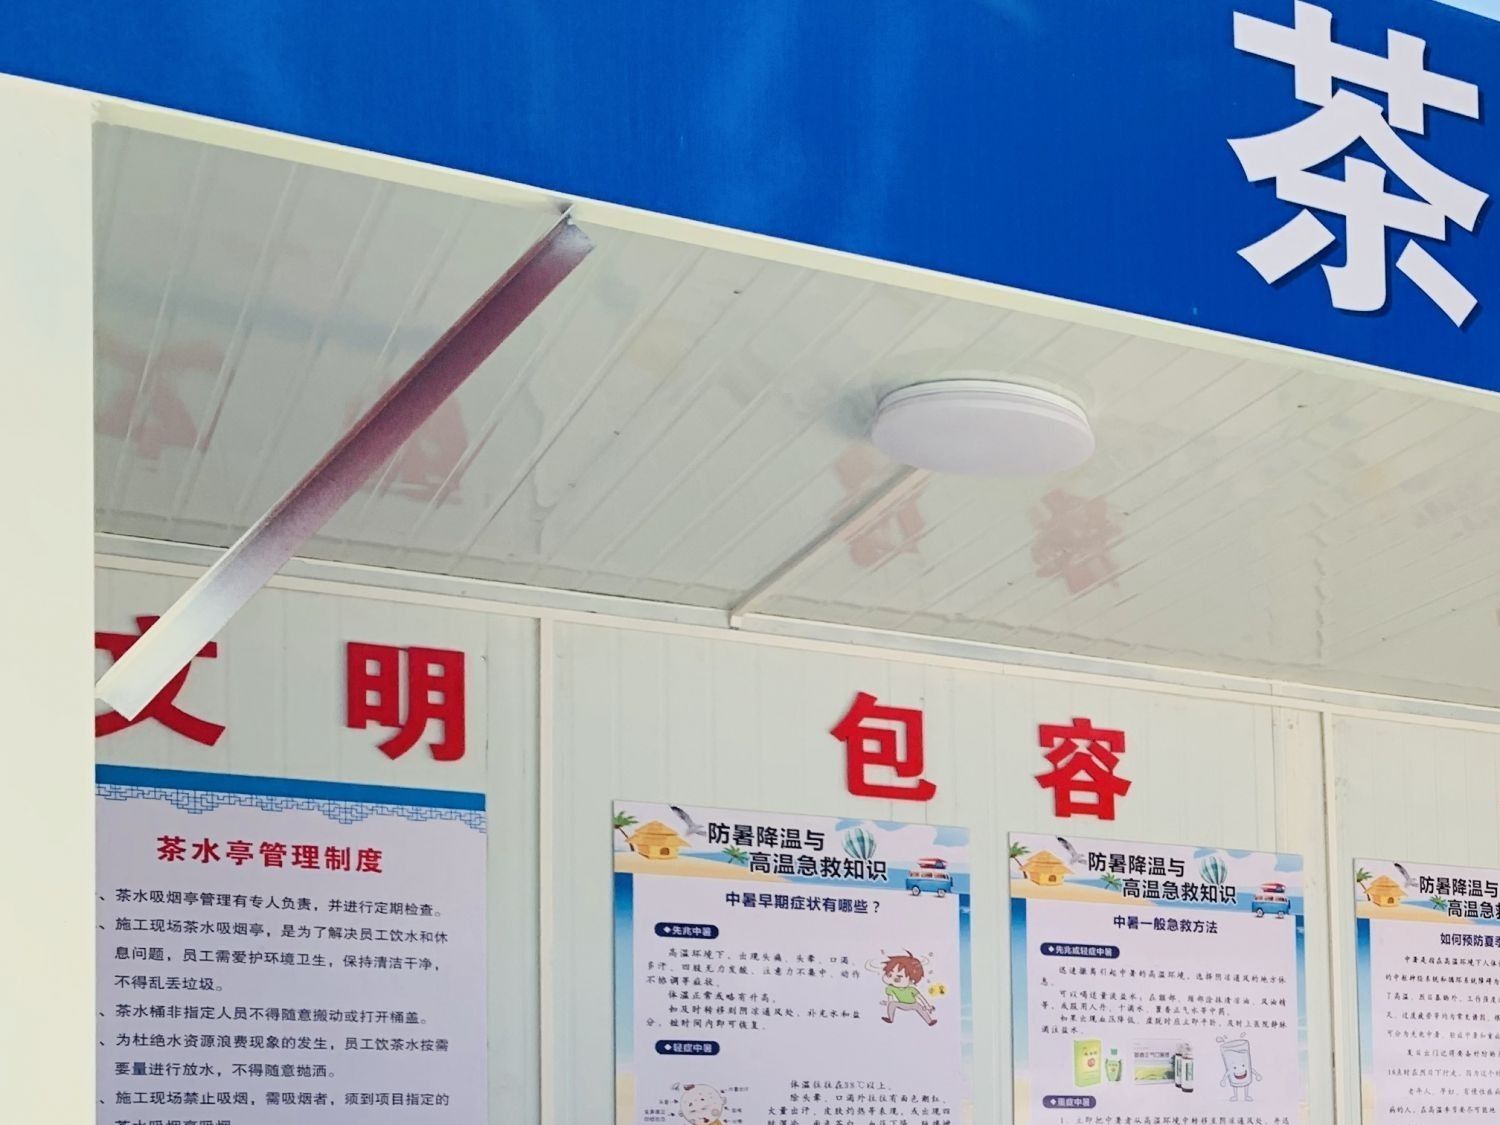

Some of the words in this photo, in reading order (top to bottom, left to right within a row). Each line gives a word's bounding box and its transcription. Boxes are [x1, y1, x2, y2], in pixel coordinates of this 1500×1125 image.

[831, 691, 1132, 821] 包容
[708, 823, 826, 852] 防暑降温与
[157, 836, 384, 873] 茶水亭管理制度
[748, 851, 888, 882] 高温急救知识
[1088, 851, 1185, 877] 防暑降温与
[1122, 878, 1237, 905] 高温急救知识
[1419, 876, 1498, 898] 防暑降温与
[725, 892, 881, 915] 中暑早期症状有哪些？
[671, 926, 712, 937] 先兆中暑
[1113, 915, 1219, 934] 中暑一般急救方法
[114, 946, 441, 972] 息问题，员工需爱护环境卫生，保持清洁干净，
[114, 975, 225, 993] 不得乱丢垃圾。
[114, 1061, 337, 1078] 要量进行放水，不得随意抛洒。
